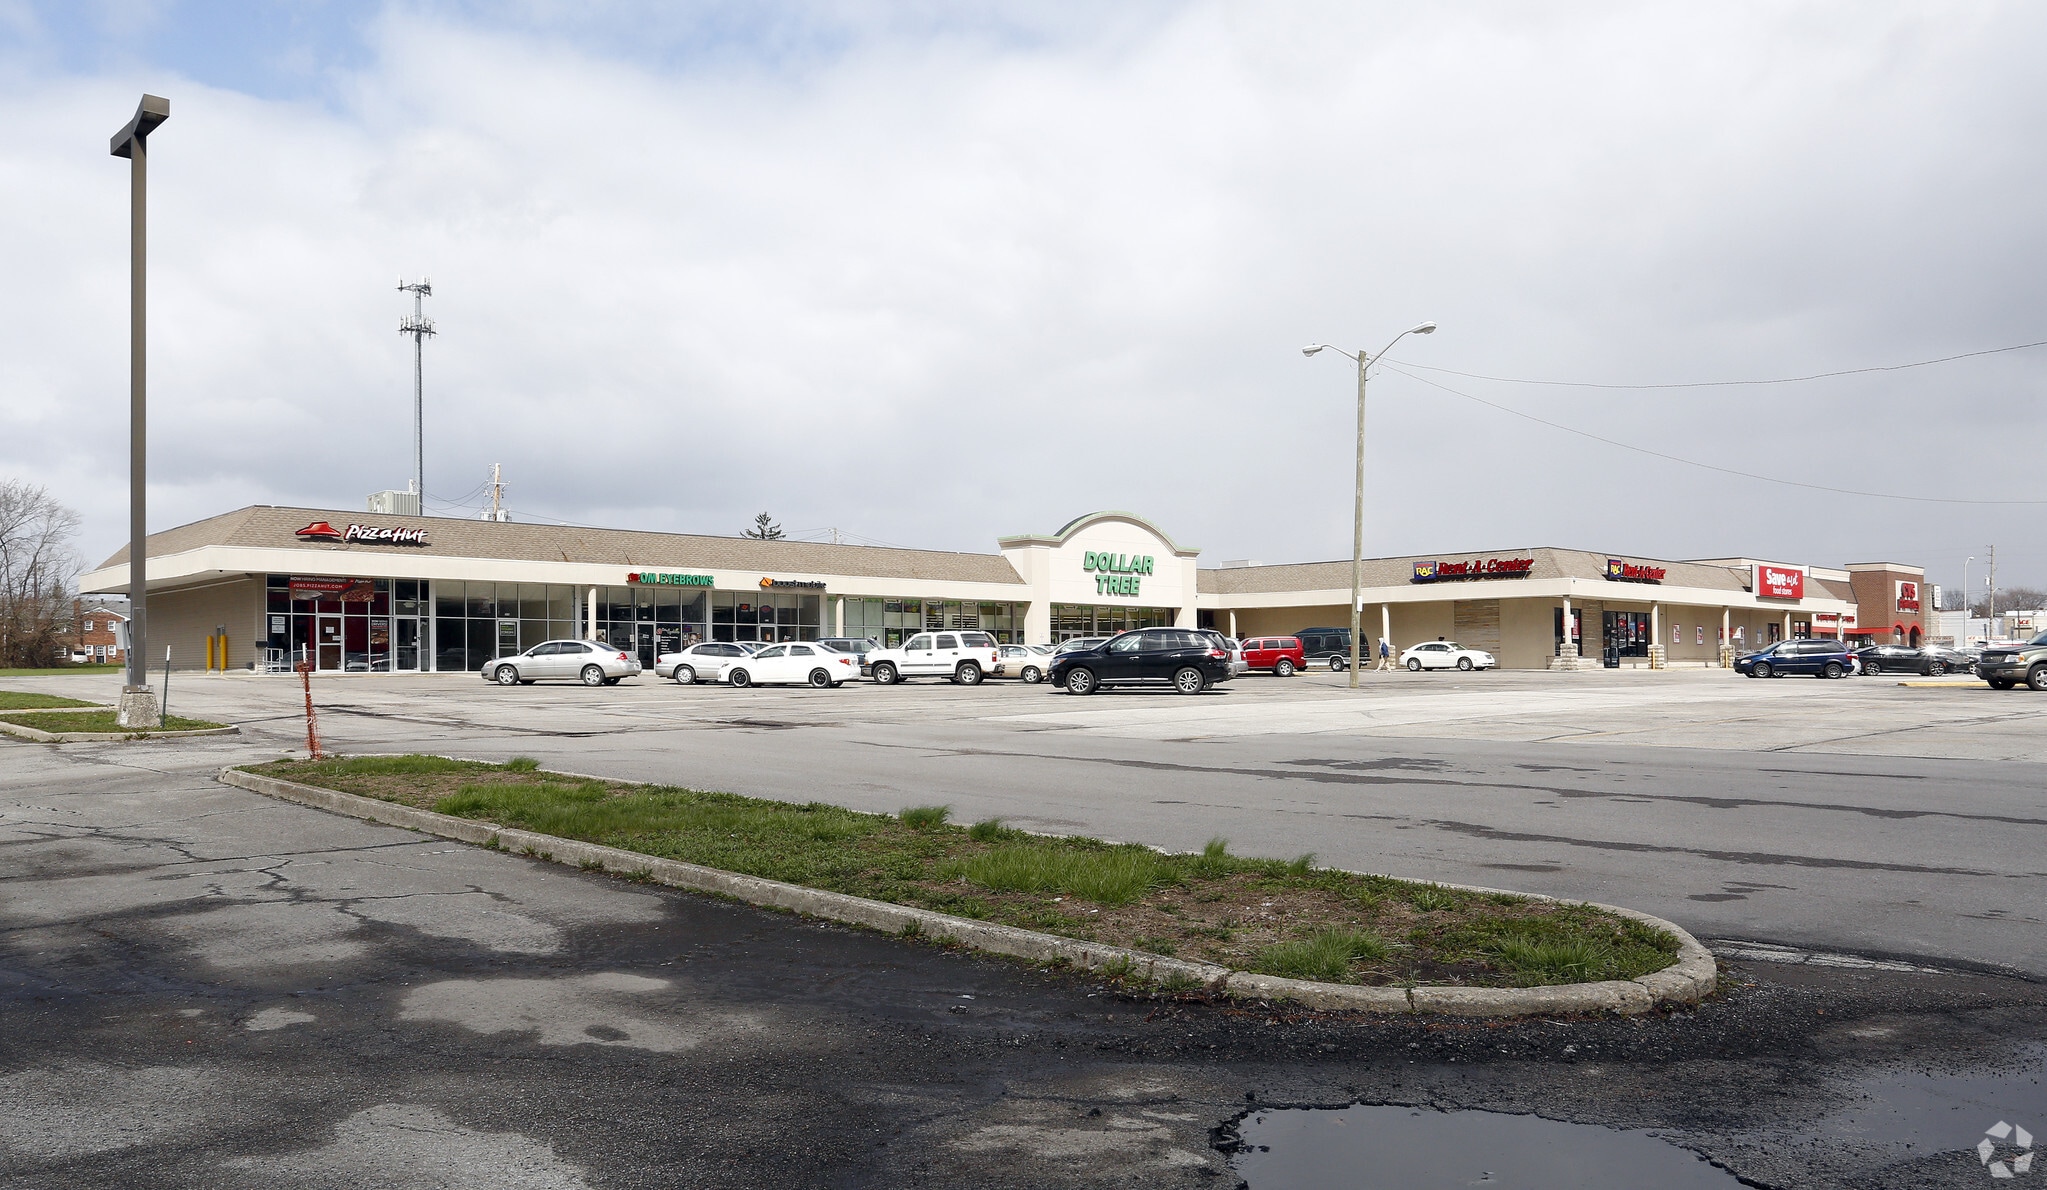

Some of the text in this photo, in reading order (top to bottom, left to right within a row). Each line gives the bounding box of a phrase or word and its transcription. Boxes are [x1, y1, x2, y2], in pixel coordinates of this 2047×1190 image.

[344, 524, 428, 543] Pizza Hut
[1084, 551, 1154, 574] DOLLAR
[659, 573, 714, 586] EYEBROWS
[1416, 567, 1433, 577] RAC
[1766, 568, 1786, 586] Save
[1096, 574, 1141, 595] TREE
[1773, 586, 1782, 594] food
